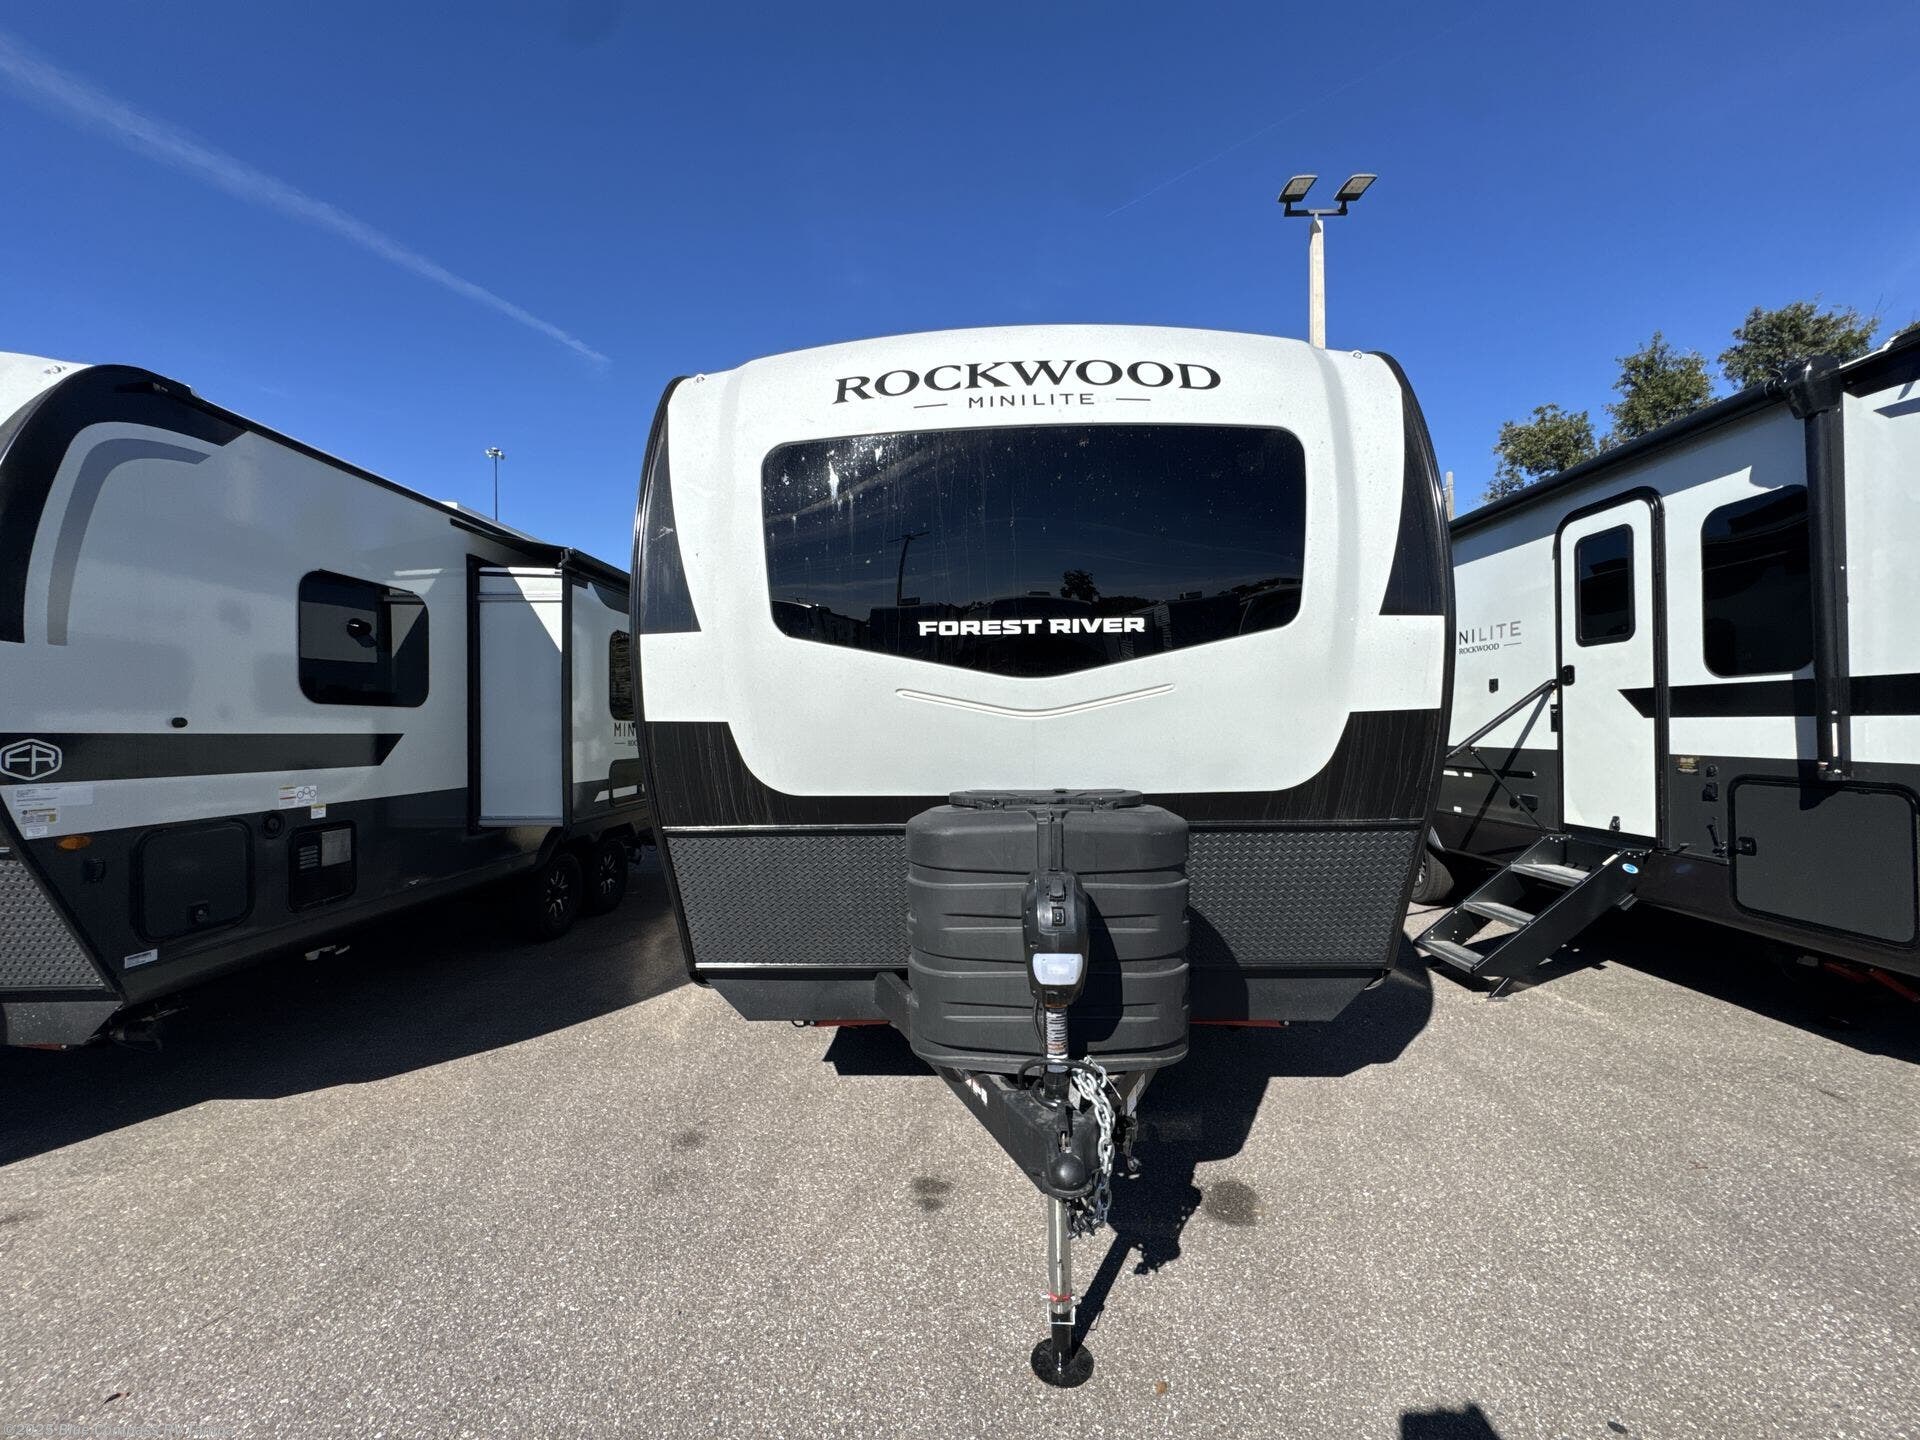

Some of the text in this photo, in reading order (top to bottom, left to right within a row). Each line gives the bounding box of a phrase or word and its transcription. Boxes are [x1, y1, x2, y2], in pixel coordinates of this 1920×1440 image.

[832, 359, 1221, 405] ROCKWOOD
[968, 392, 1096, 408] MINILITE
[918, 616, 1146, 637] FOREST RIVER
[1458, 643, 1500, 655] ROCKWOOD
